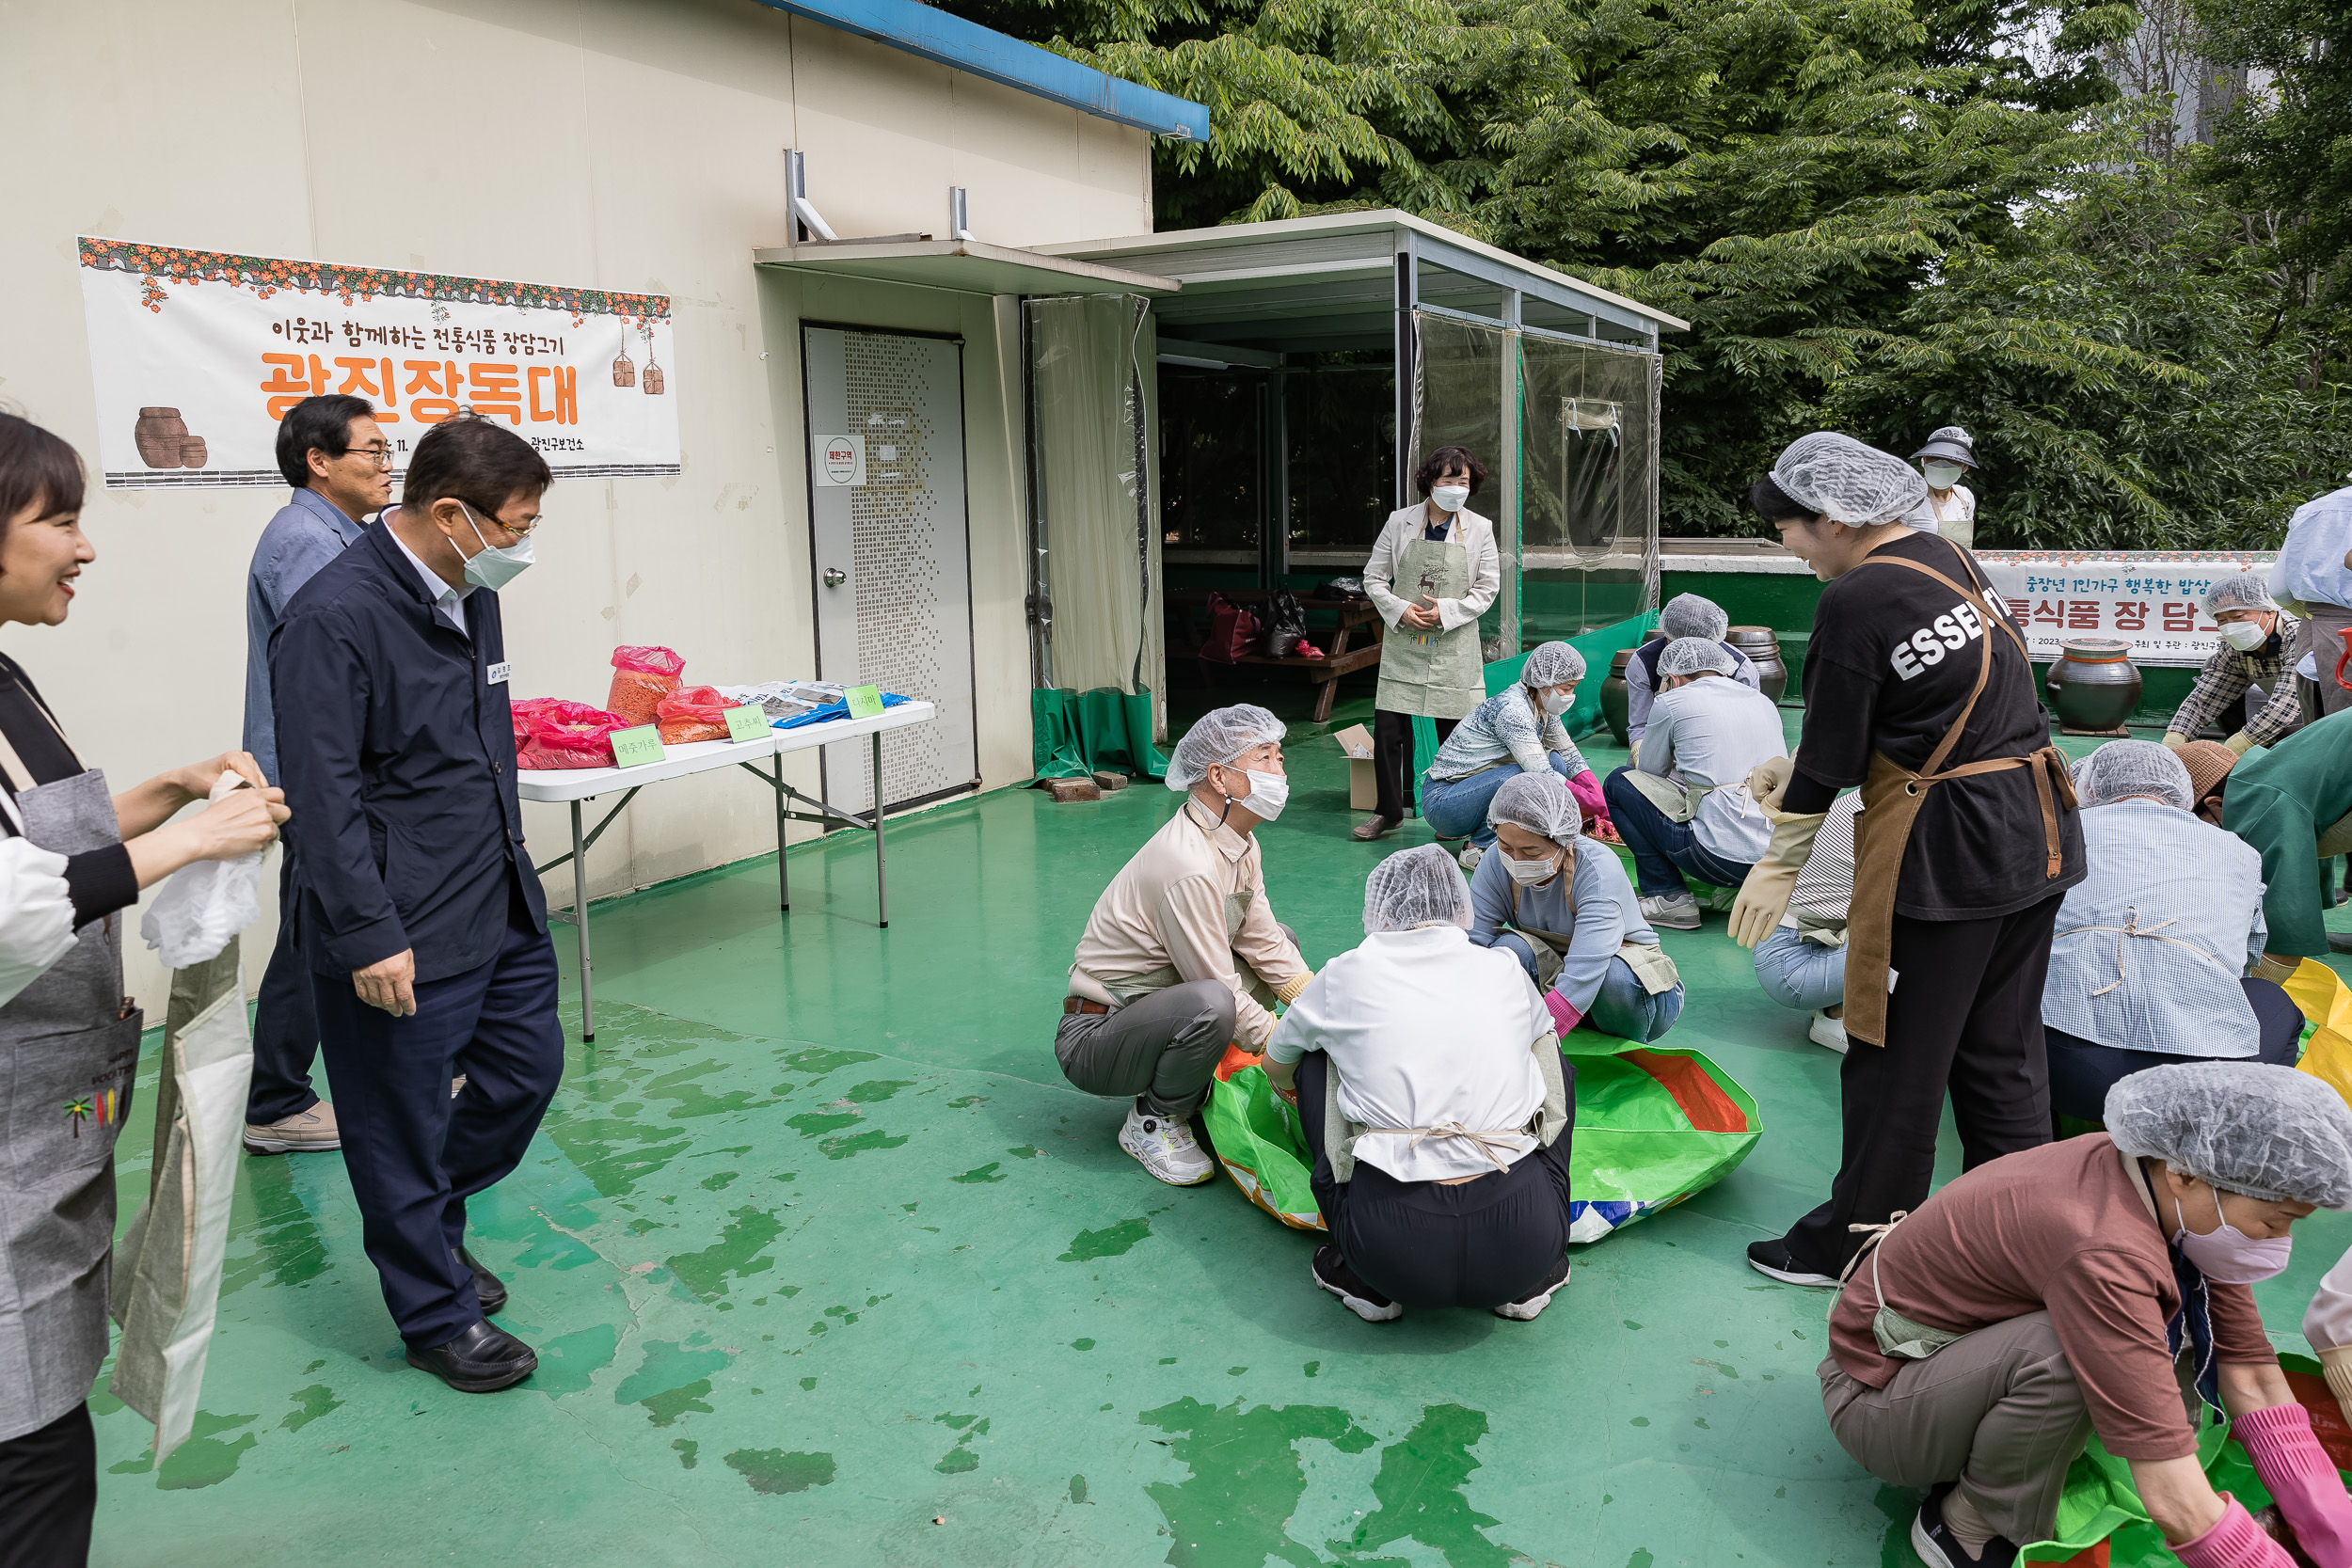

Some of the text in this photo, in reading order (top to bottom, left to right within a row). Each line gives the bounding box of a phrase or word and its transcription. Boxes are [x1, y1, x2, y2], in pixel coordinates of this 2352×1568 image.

[272, 317, 564, 356] 이웃과 함께하는 전통식품 장담그기
[261, 352, 579, 426] 광진장독대
[531, 436, 585, 452] 광진구보건소
[828, 451, 852, 460] 제한구역
[2026, 576, 2212, 595] 중장년 1인가구 행복한 밥상
[2114, 601, 2151, 631] 장
[2162, 602, 2221, 632] 담
[2134, 640, 2150, 649] 주최
[2165, 641, 2182, 650] 주관
[851, 694, 877, 708] 다시마
